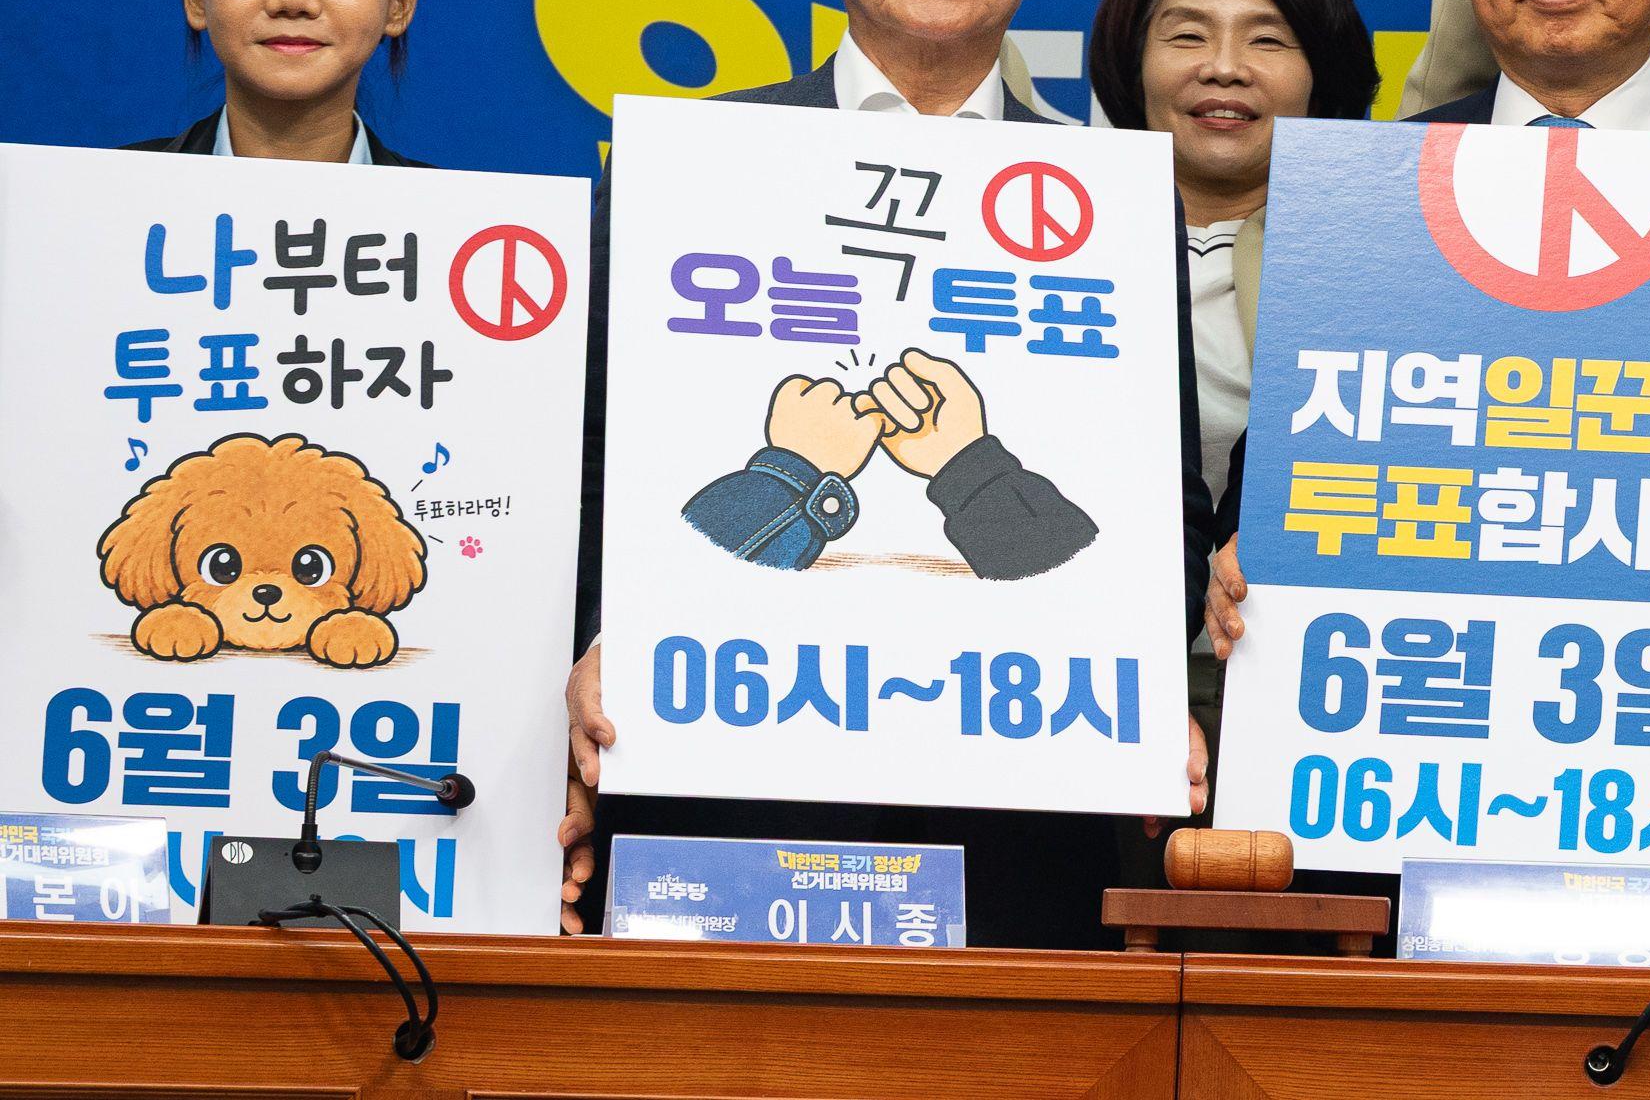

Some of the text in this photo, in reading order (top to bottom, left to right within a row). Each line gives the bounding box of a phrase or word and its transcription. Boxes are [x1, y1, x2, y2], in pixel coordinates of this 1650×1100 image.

[144, 213, 418, 316] 나부터
[667, 161, 1120, 358] 오늘 꼭 투표
[104, 328, 453, 423] 투표하자
[414, 496, 512, 522] 투표하라멍!
[652, 636, 1142, 744] 06시~18시
[1298, 613, 1496, 740] 6월
[41, 687, 460, 816] 6월 3일
[648, 881, 709, 902] 민주당
[776, 849, 922, 874] 대한민국 국가 정상화
[791, 872, 908, 892] 선거대책위원회
[1563, 872, 1625, 893] 대한민국
